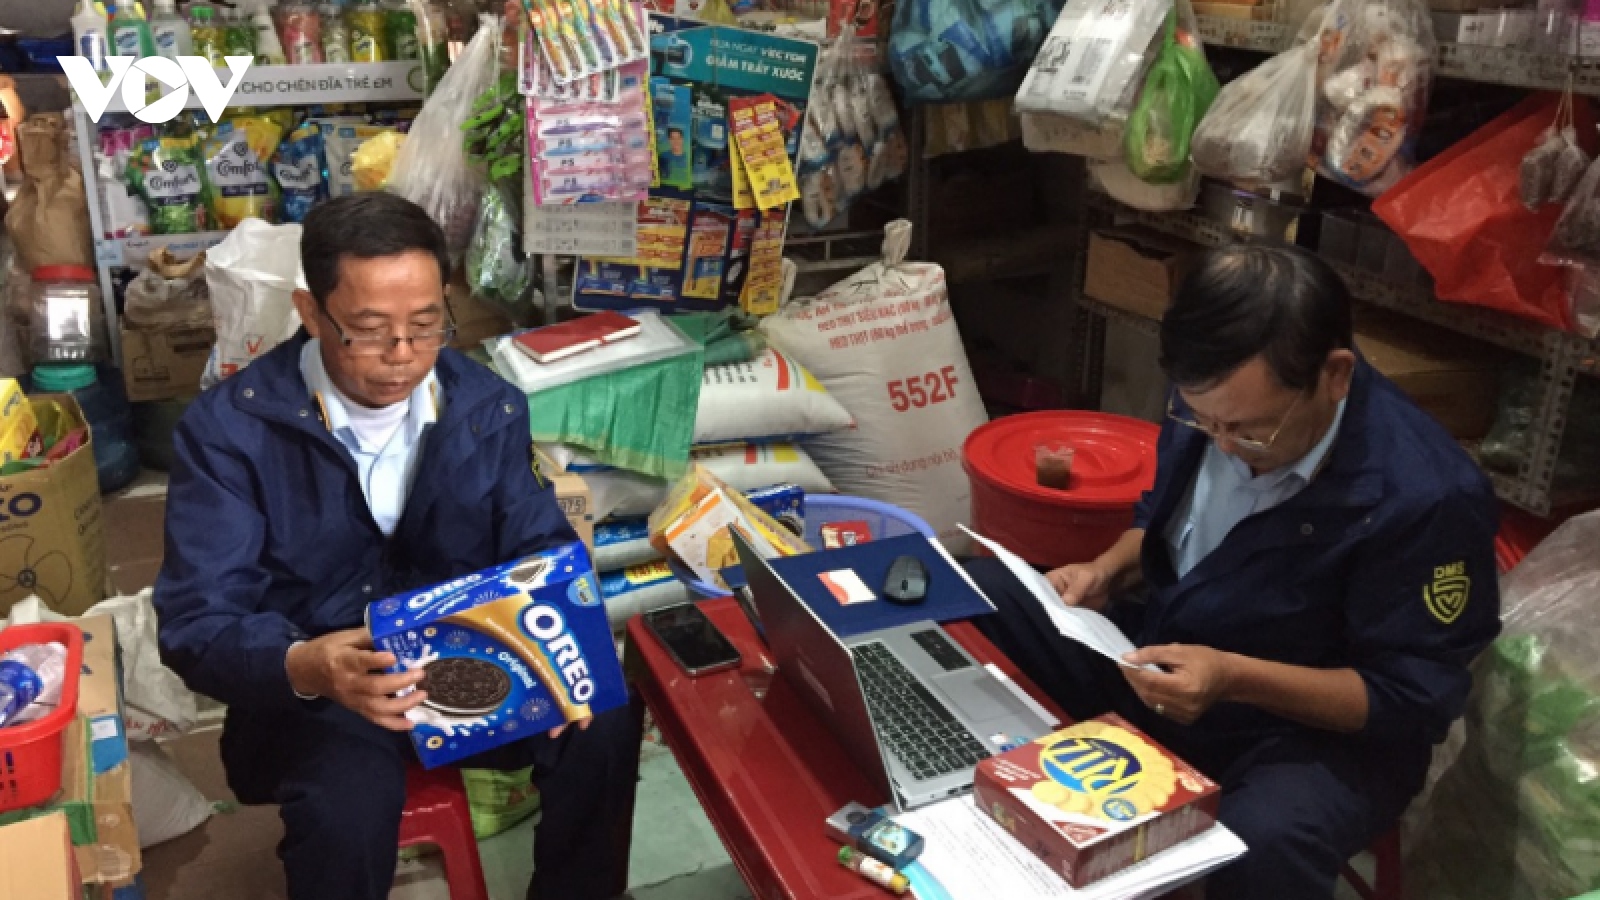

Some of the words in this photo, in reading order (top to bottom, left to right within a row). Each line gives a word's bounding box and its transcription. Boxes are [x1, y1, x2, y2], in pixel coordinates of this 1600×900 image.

[241, 81, 274, 94] CHO
[886, 366, 958, 412] 552F
[1433, 561, 1465, 579] DMS
[523, 603, 595, 702] OREO
[1042, 737, 1145, 796] RITZ
